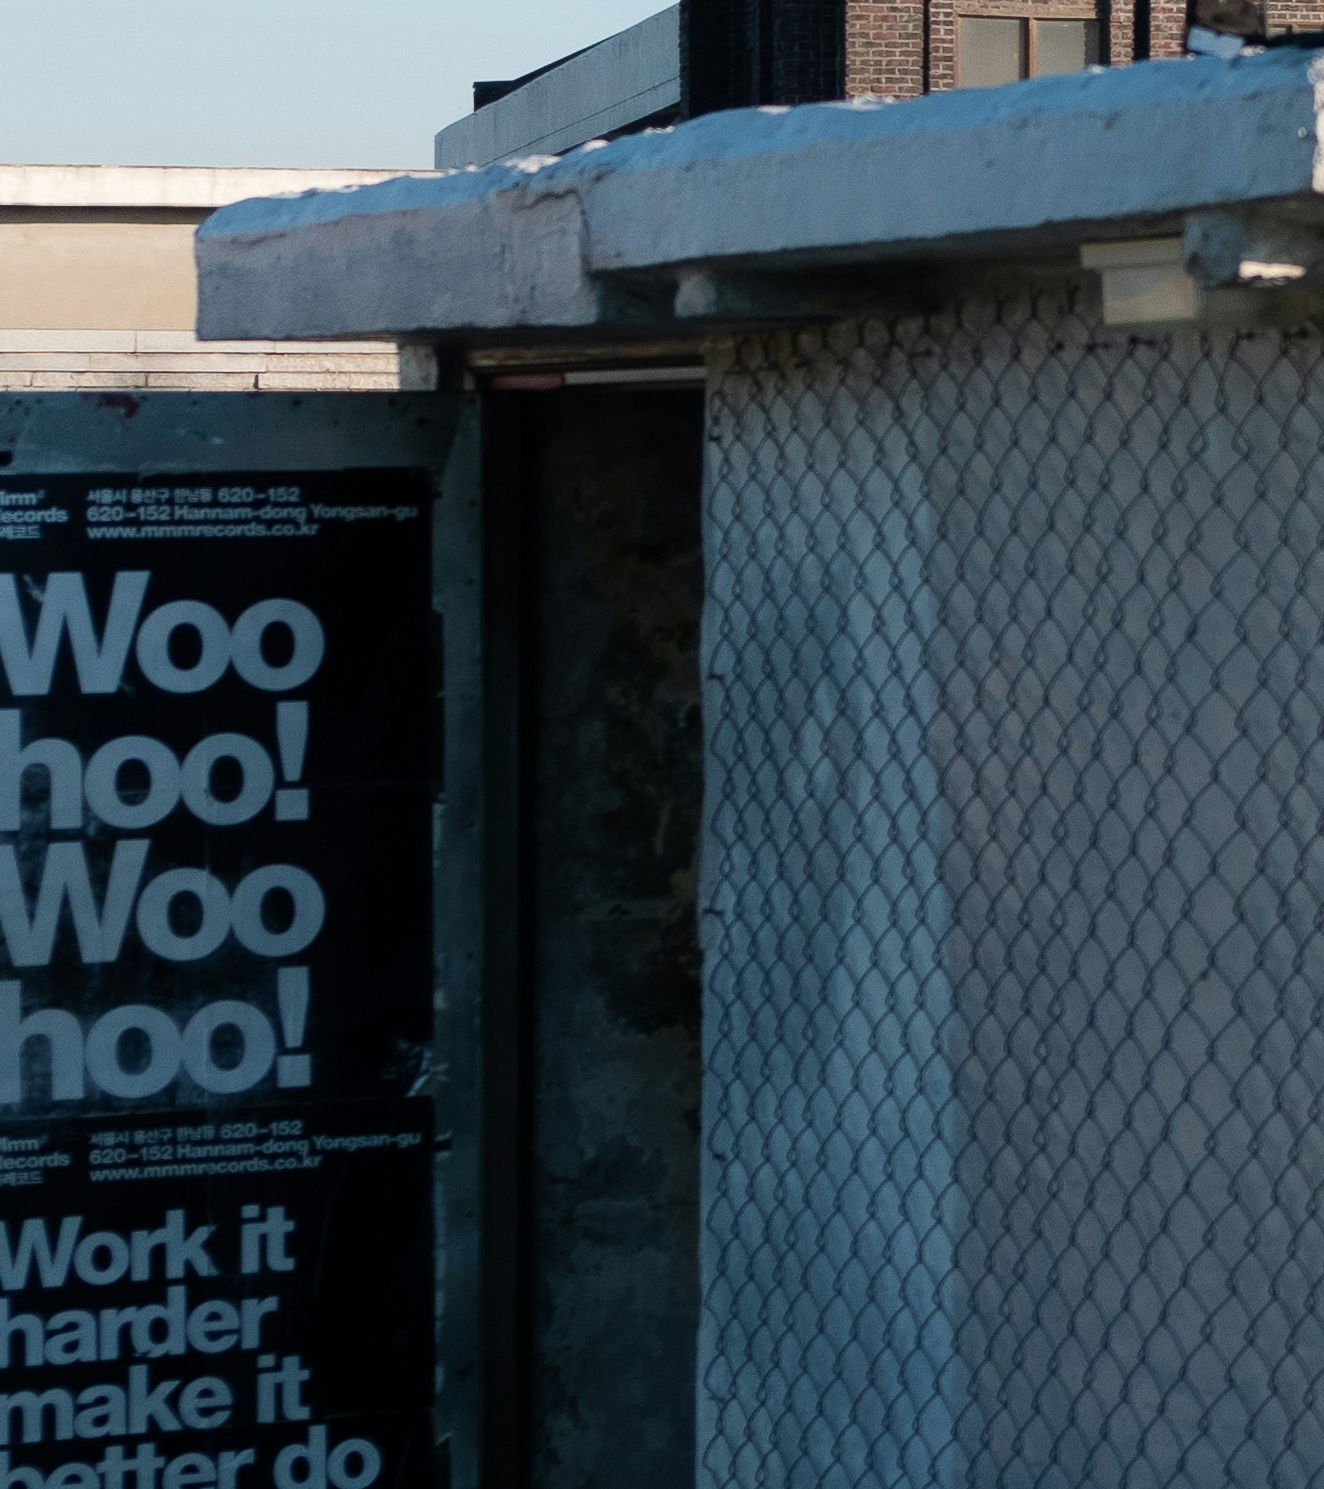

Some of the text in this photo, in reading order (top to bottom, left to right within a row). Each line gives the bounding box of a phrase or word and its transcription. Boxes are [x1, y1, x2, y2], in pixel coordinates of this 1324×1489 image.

[0, 507, 68, 523] ecords
[86, 503, 418, 523] 620-152 Hannam-dong Yongsan-gu
[0, 524, 41, 539] 레코드
[87, 522, 320, 539] www.mmmrecords.co.kr
[0, 571, 325, 696] Woo
[0, 701, 309, 831] hoo!
[0, 839, 325, 967] Woo
[0, 966, 312, 1102] hoo!
[220, 1120, 303, 1139] 620-152
[0, 1152, 70, 1170] ecords
[89, 1131, 421, 1165] 620-152 Hannam-dong Yongsan-gu
[0, 1171, 43, 1187] 레코드
[89, 1153, 323, 1184] www.mmmrecords.co.kr
[0, 1205, 295, 1289] Work it
[0, 1286, 278, 1368] harder
[0, 1354, 310, 1443] make it
